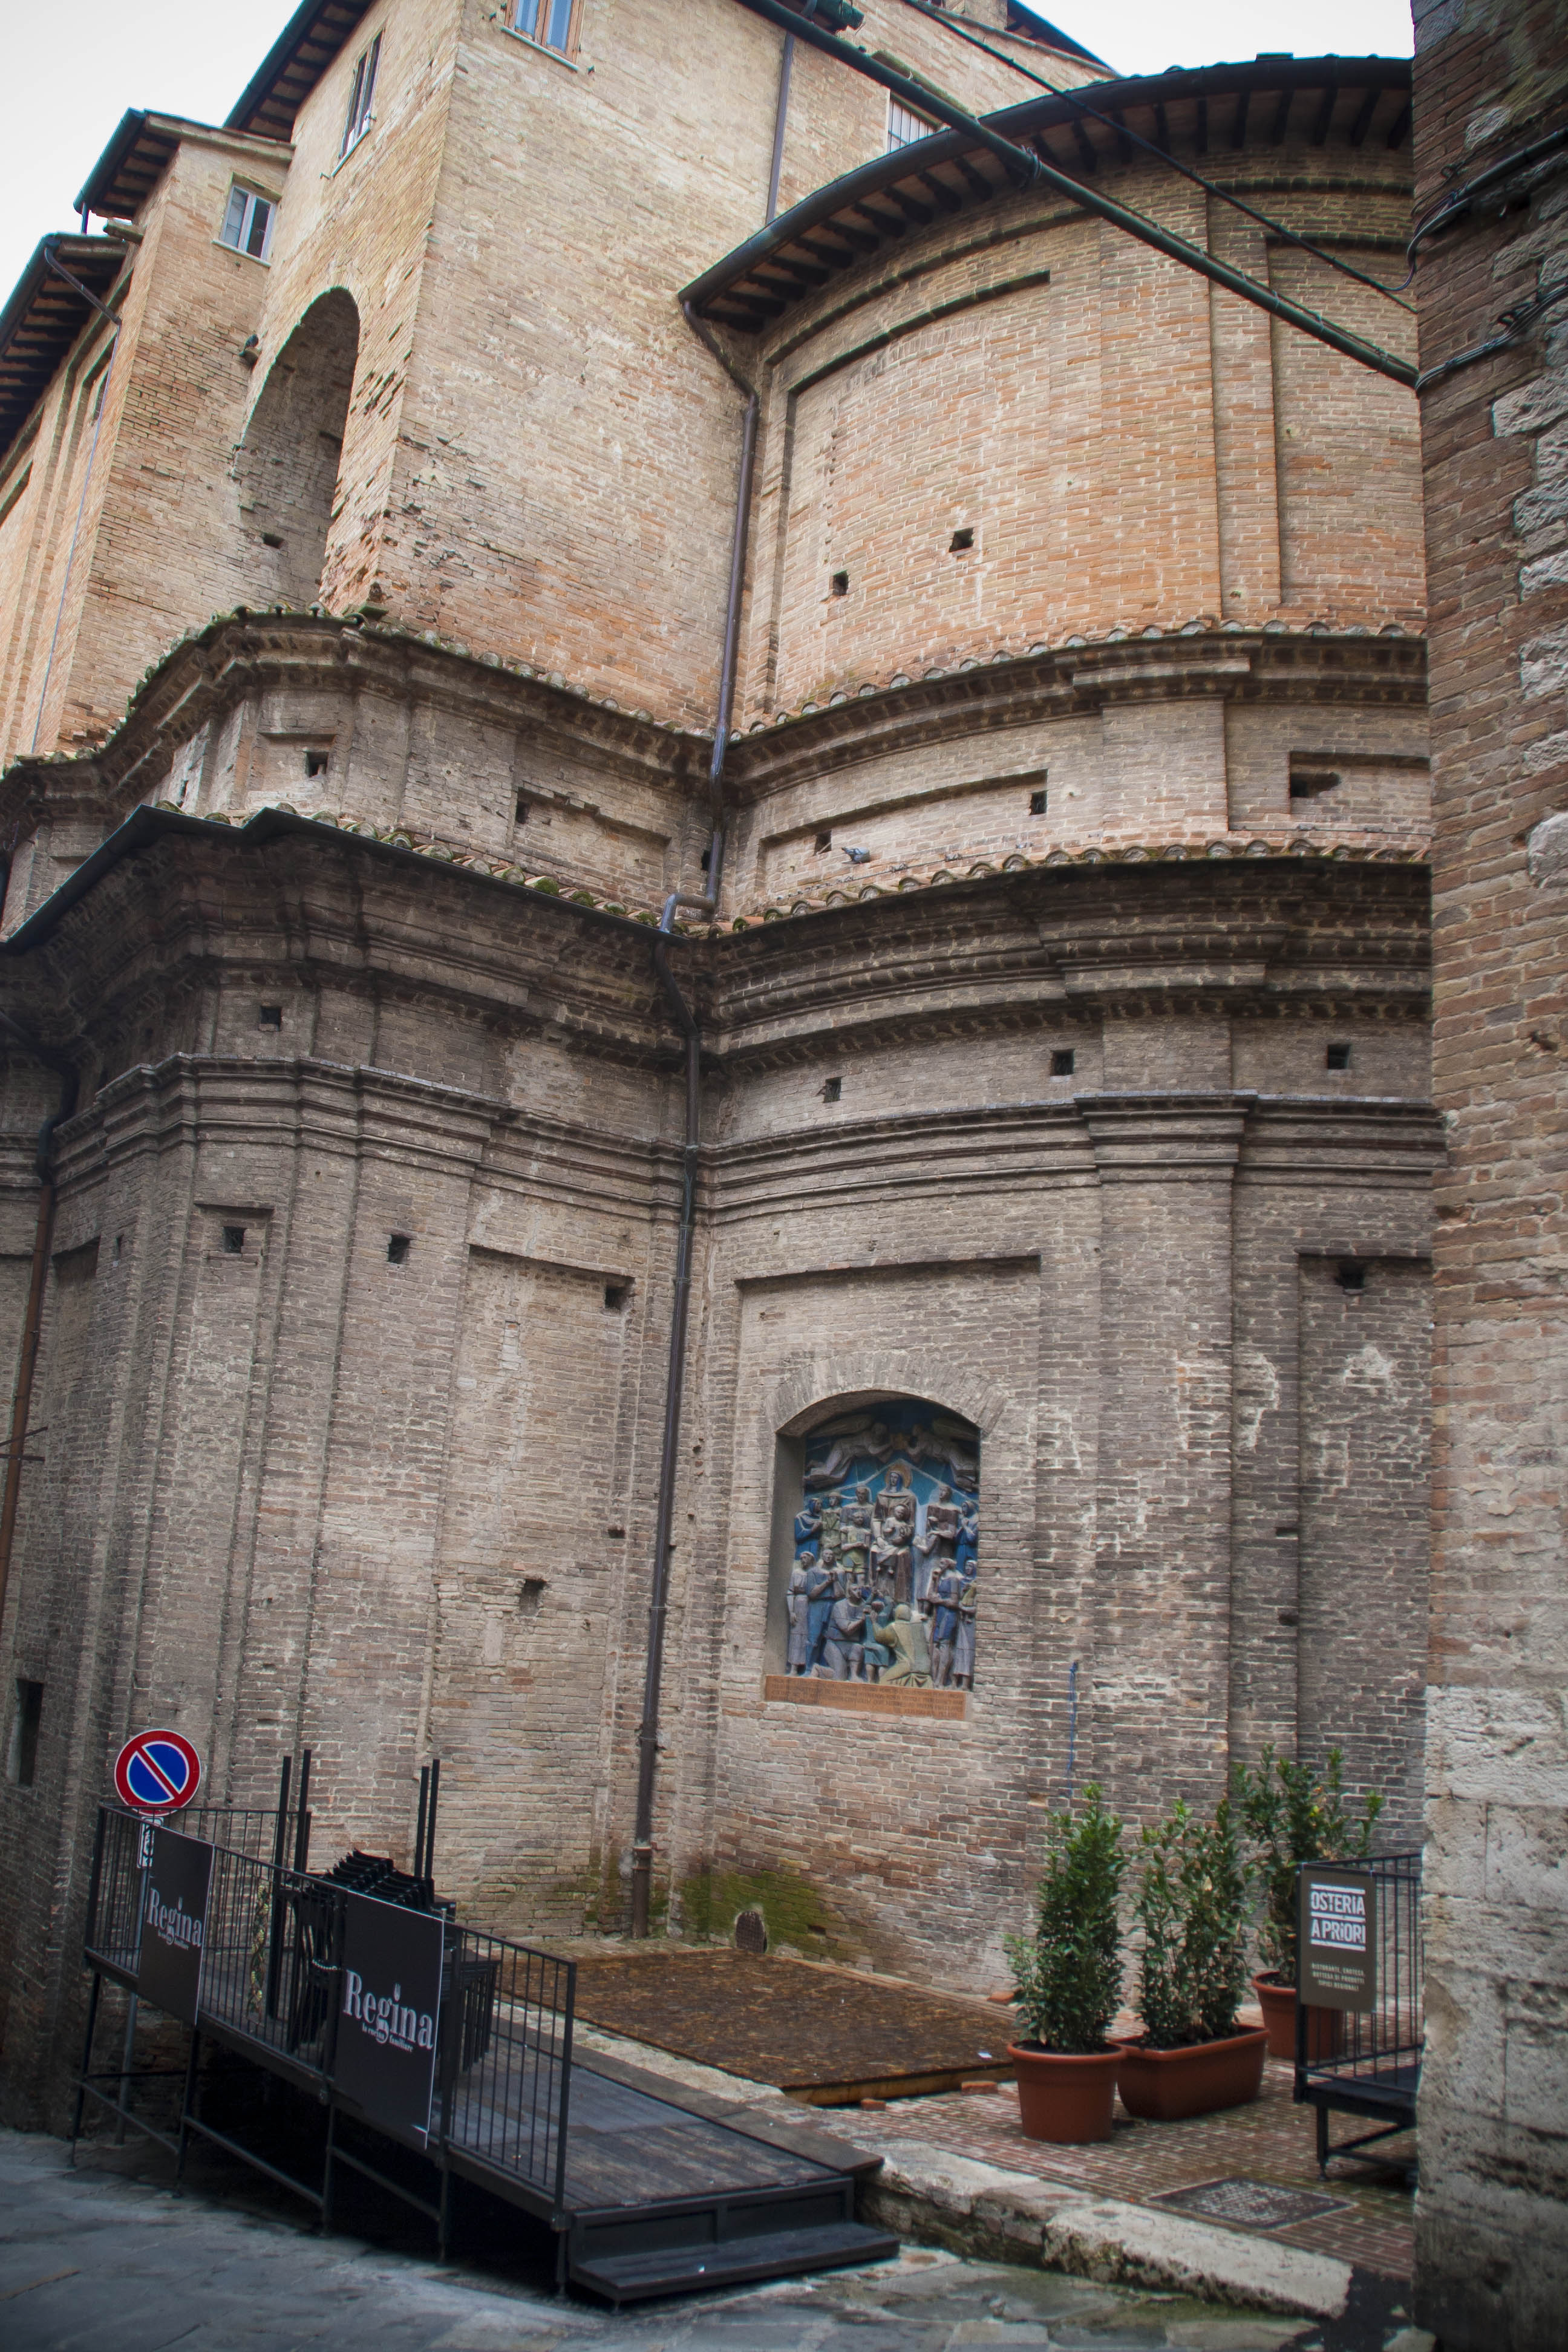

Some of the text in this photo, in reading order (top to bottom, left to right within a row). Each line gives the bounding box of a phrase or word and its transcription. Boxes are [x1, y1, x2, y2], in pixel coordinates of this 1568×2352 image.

[147, 1887, 202, 1947] Regina
[1310, 1890, 1365, 1916] OSTERIA
[1311, 1918, 1321, 1938] A
[343, 1969, 433, 2051] Regina
